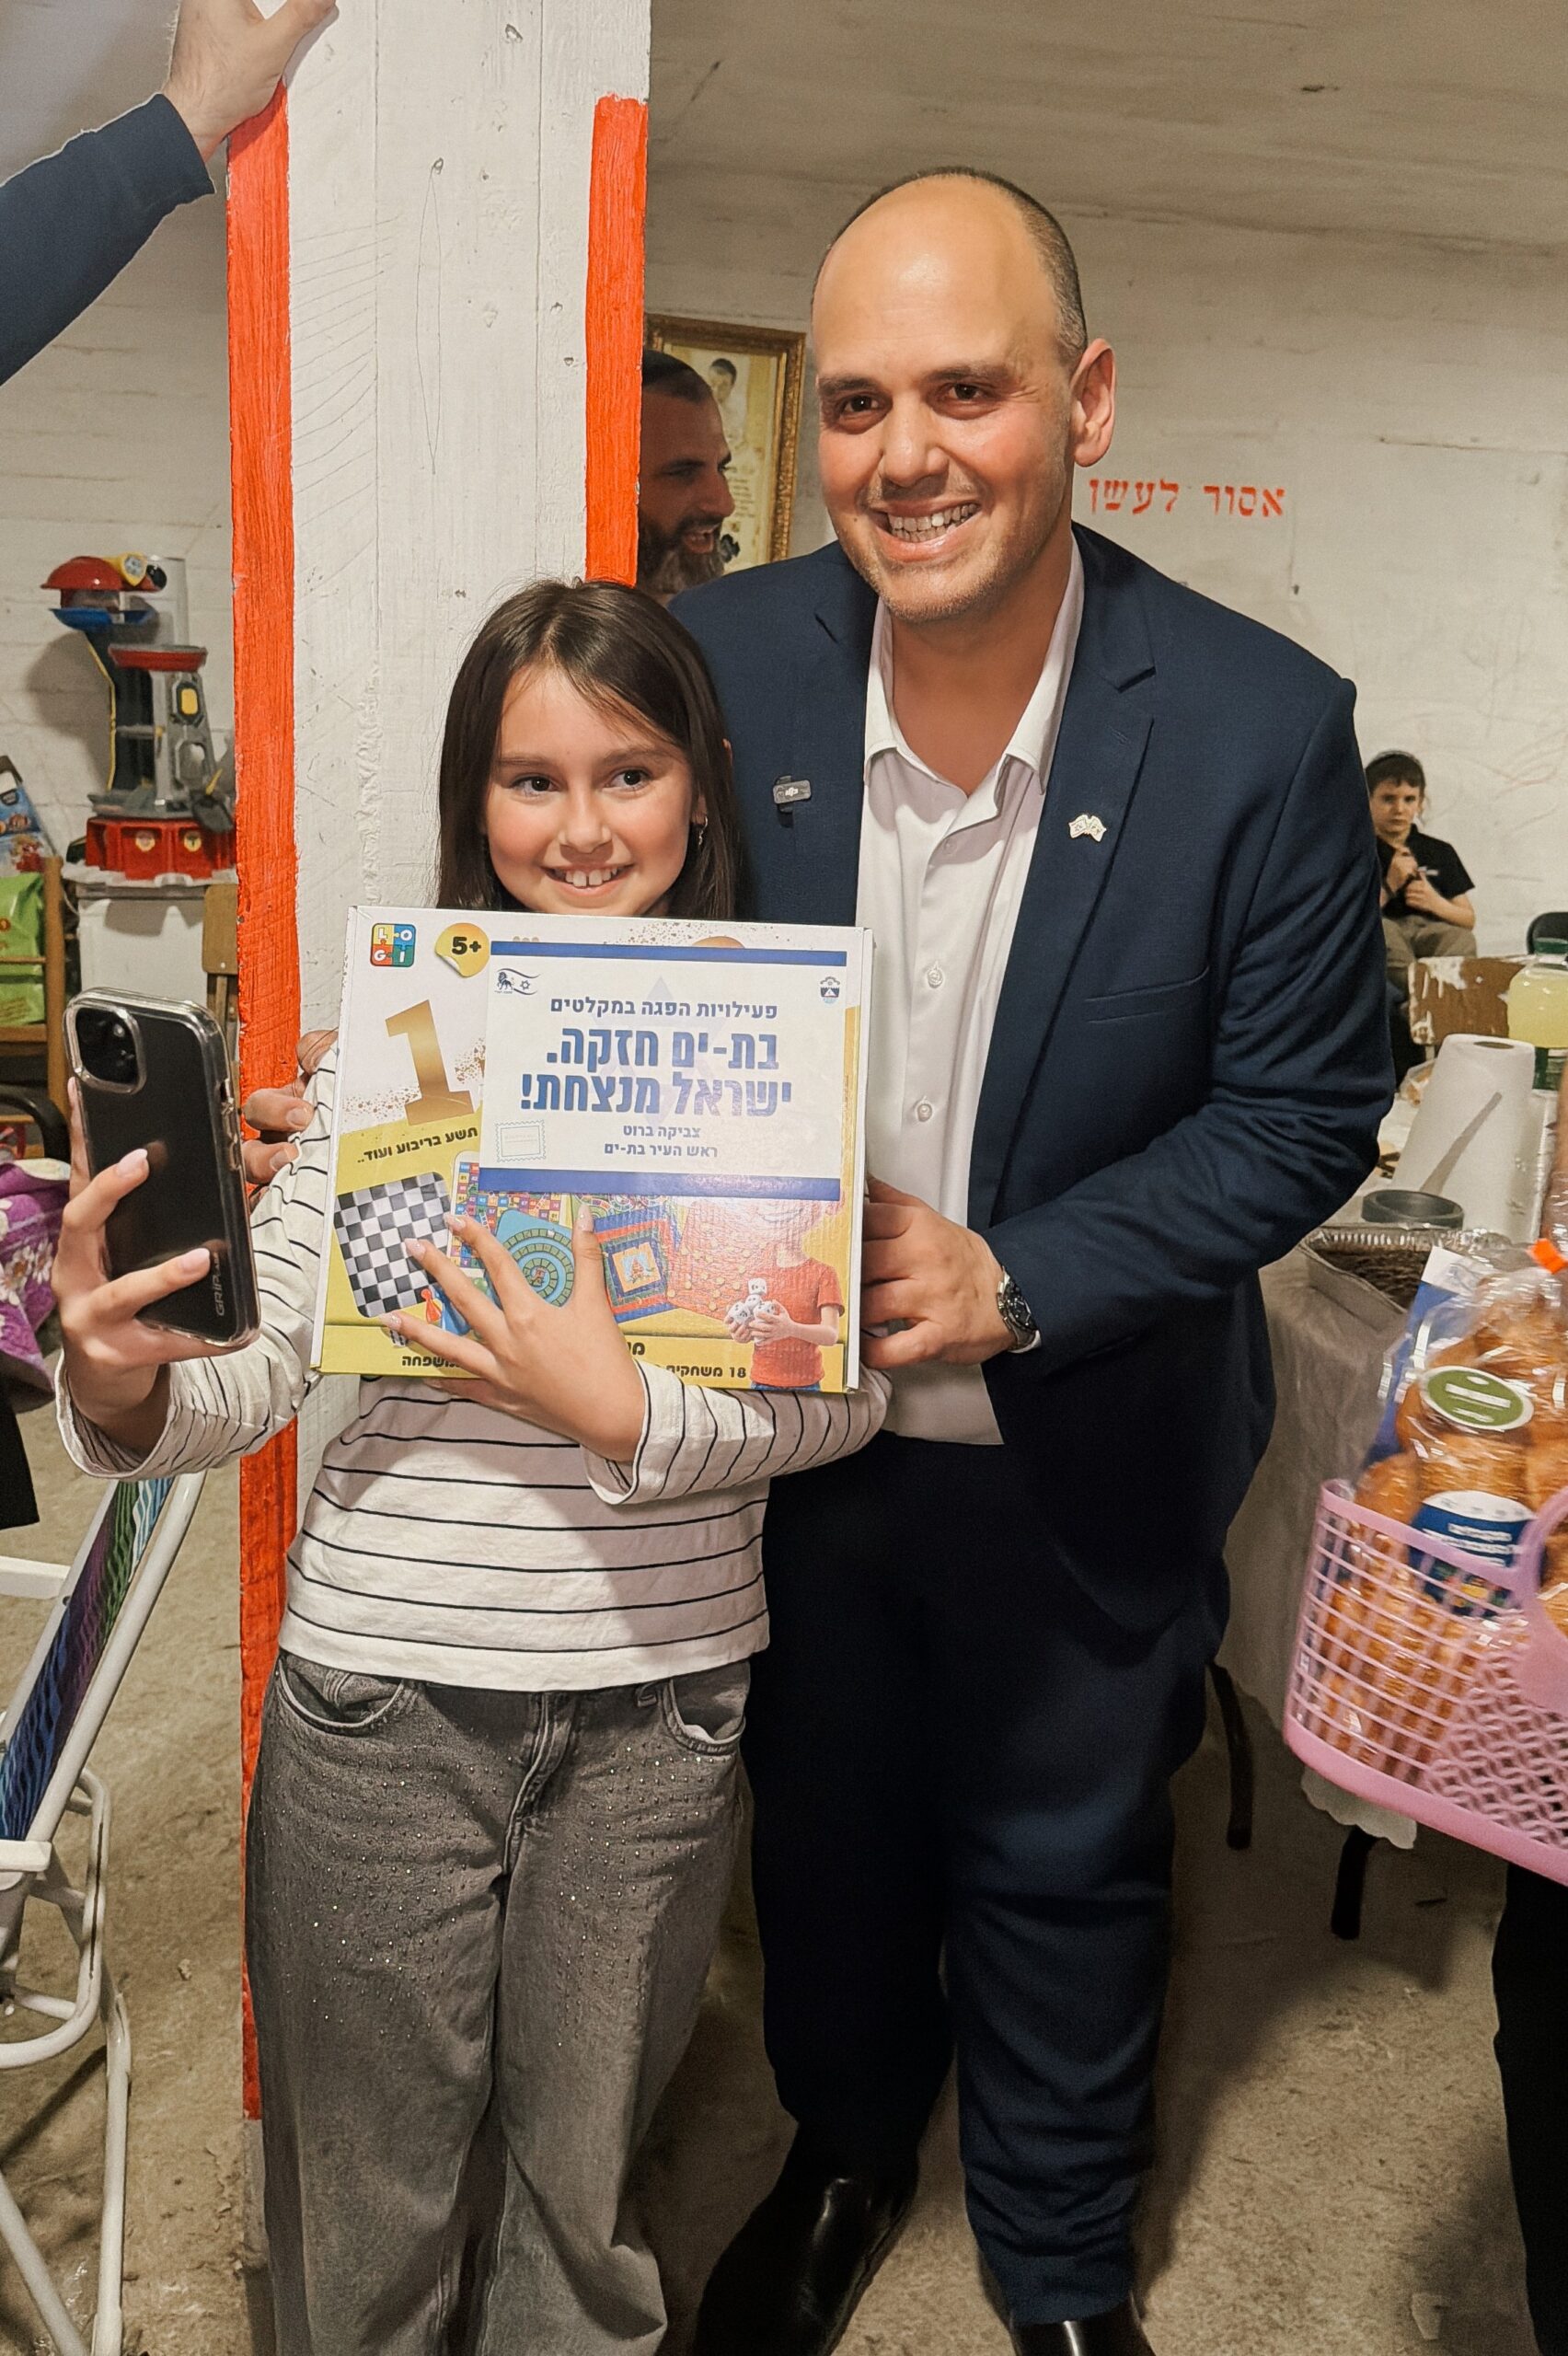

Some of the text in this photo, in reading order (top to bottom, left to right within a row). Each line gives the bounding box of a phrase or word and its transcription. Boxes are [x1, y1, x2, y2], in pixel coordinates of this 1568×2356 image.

[1089, 479, 1285, 517] אסור לעשן
[452, 936, 482, 955] 5+
[550, 997, 778, 1019] פעילויות הפגה במקלטים
[547, 1028, 779, 1073] בת-ים חזקה.
[385, 999, 475, 1126] 1
[520, 1073, 661, 1114] מנצחת!
[672, 1071, 792, 1116] ישראל
[446, 1127, 478, 1143] תשע
[623, 1124, 701, 1140] צביקה ברוט
[397, 1136, 442, 1155] בריבוע
[604, 1142, 718, 1158] ראש העיר בת-ים
[402, 1356, 462, 1369] שפחה
[730, 1367, 746, 1378] 18
